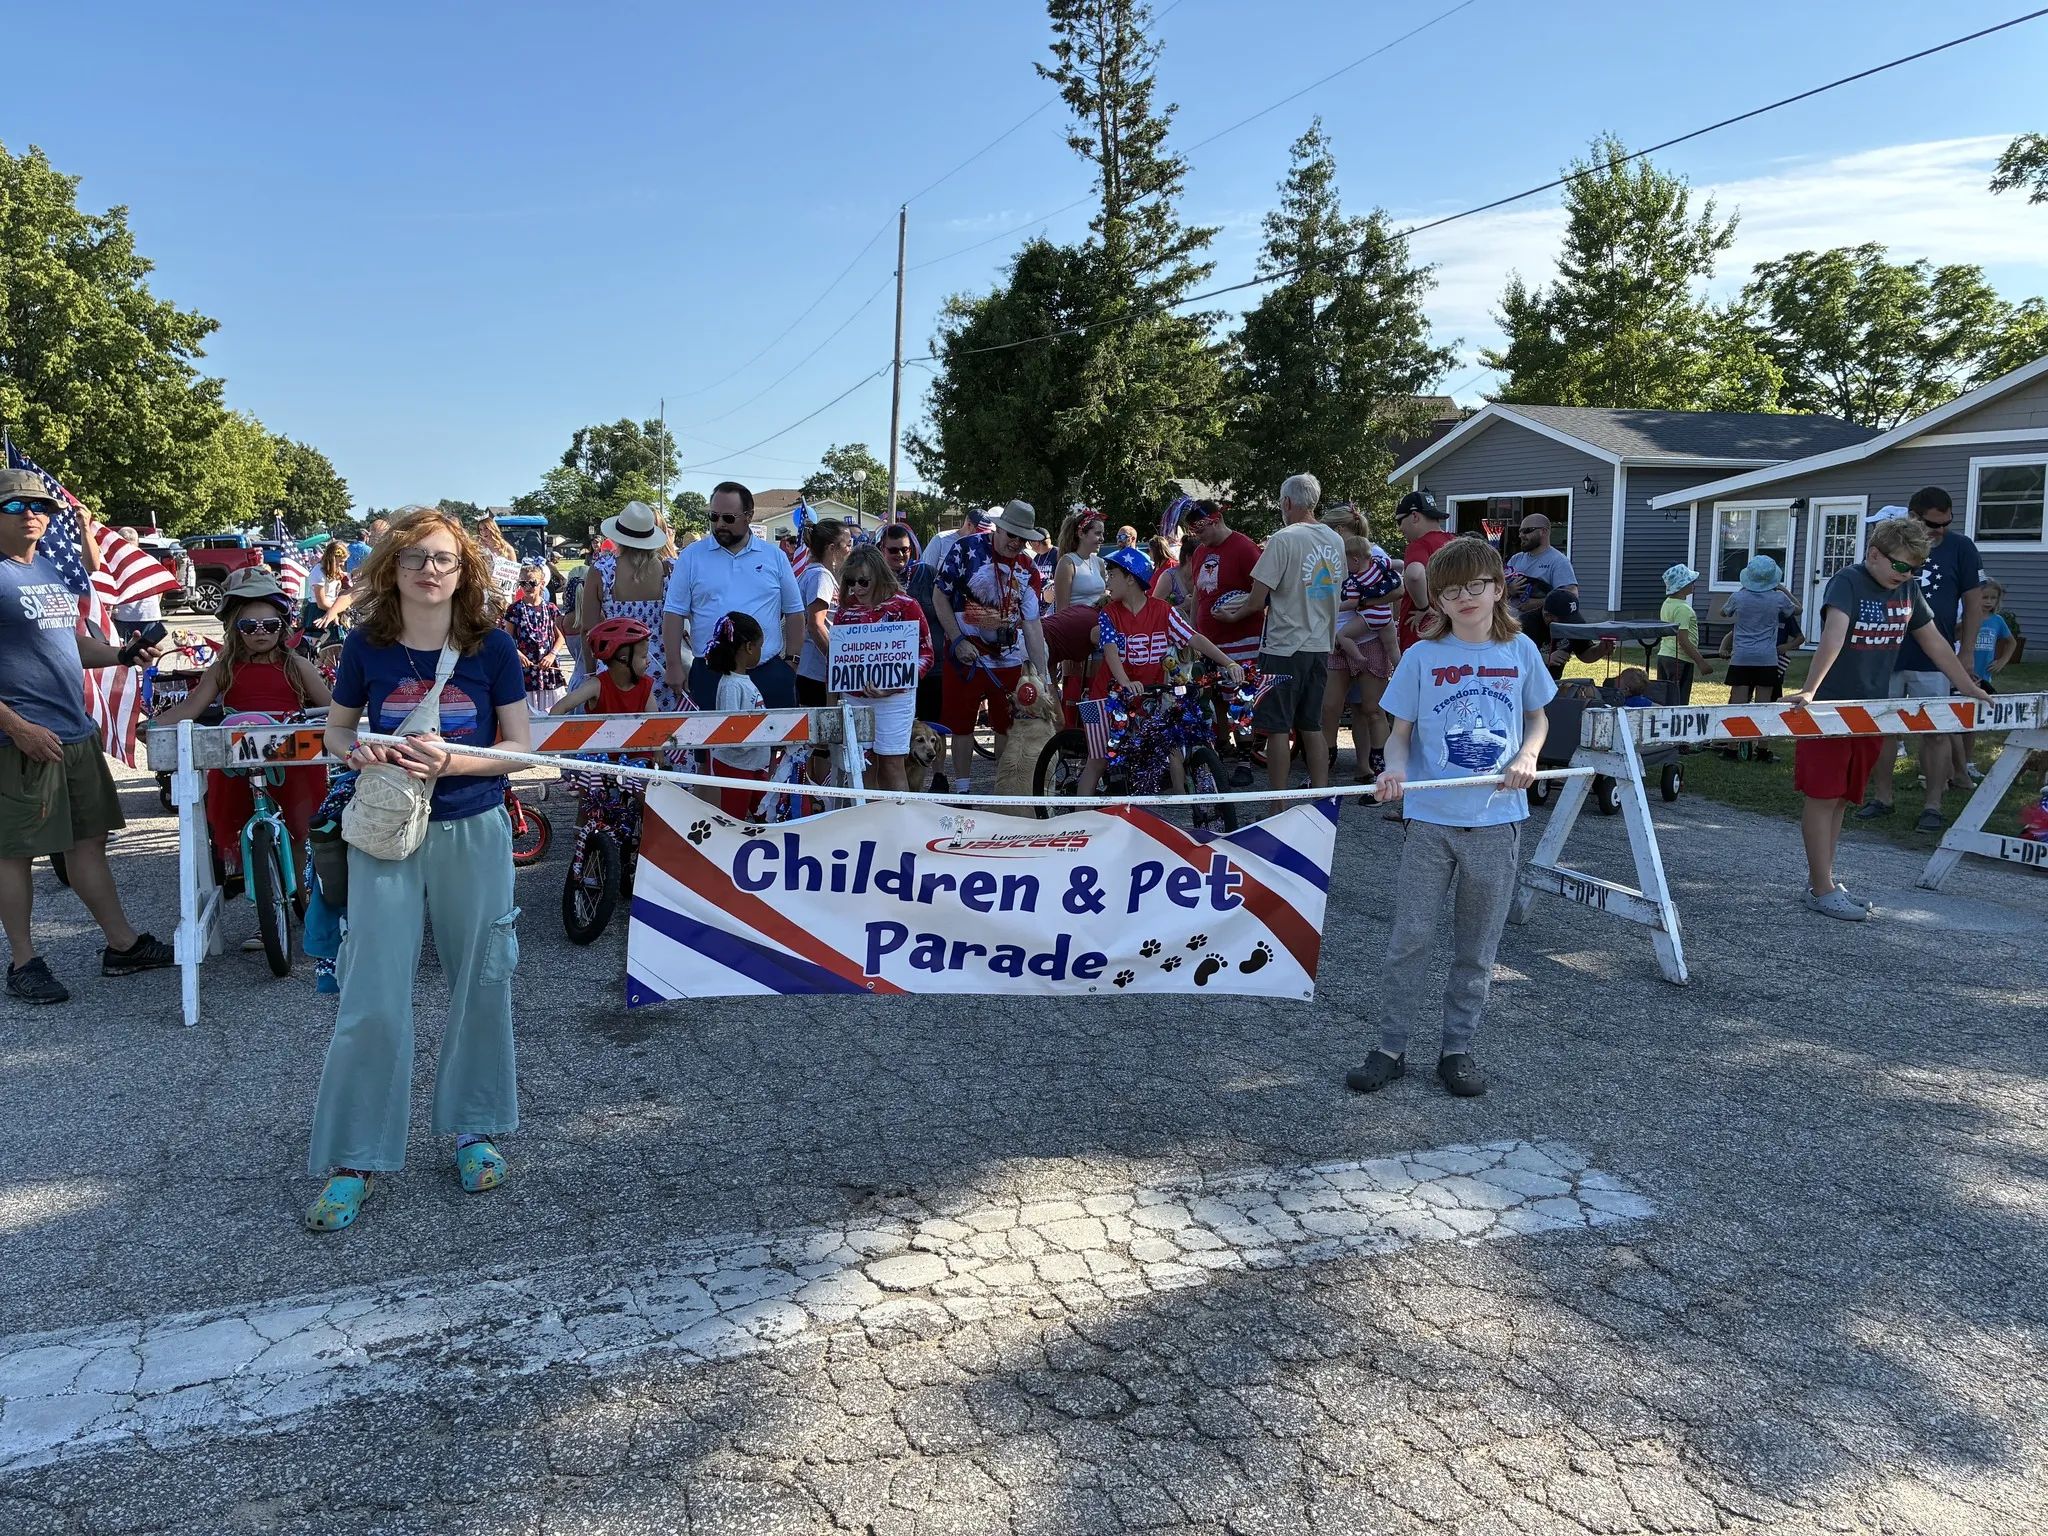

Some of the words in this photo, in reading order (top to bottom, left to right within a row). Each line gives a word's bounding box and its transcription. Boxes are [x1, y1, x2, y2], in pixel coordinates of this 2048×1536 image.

[846, 626, 861, 635] JCI
[870, 624, 904, 633] Ludington
[834, 653, 865, 664] PARADE
[867, 651, 914, 663] CATEGORY:
[841, 641, 882, 653] CHILDREN
[891, 640, 907, 649] PET
[831, 662, 915, 691] PATRIOTISM
[1431, 664, 1474, 686] 70th
[1432, 688, 1480, 715] Freedom
[1481, 686, 1514, 713] Festival
[1977, 702, 2030, 725] L-DPW
[1650, 712, 1710, 738] L-DPW
[990, 833, 1055, 843] Ludington
[2000, 838, 2048, 865] L-DP
[732, 832, 1040, 913] Children
[1062, 865, 1106, 915] &
[1126, 854, 1244, 914] Pet
[1559, 874, 1610, 911] L-DPW
[865, 920, 1108, 981] Parade
